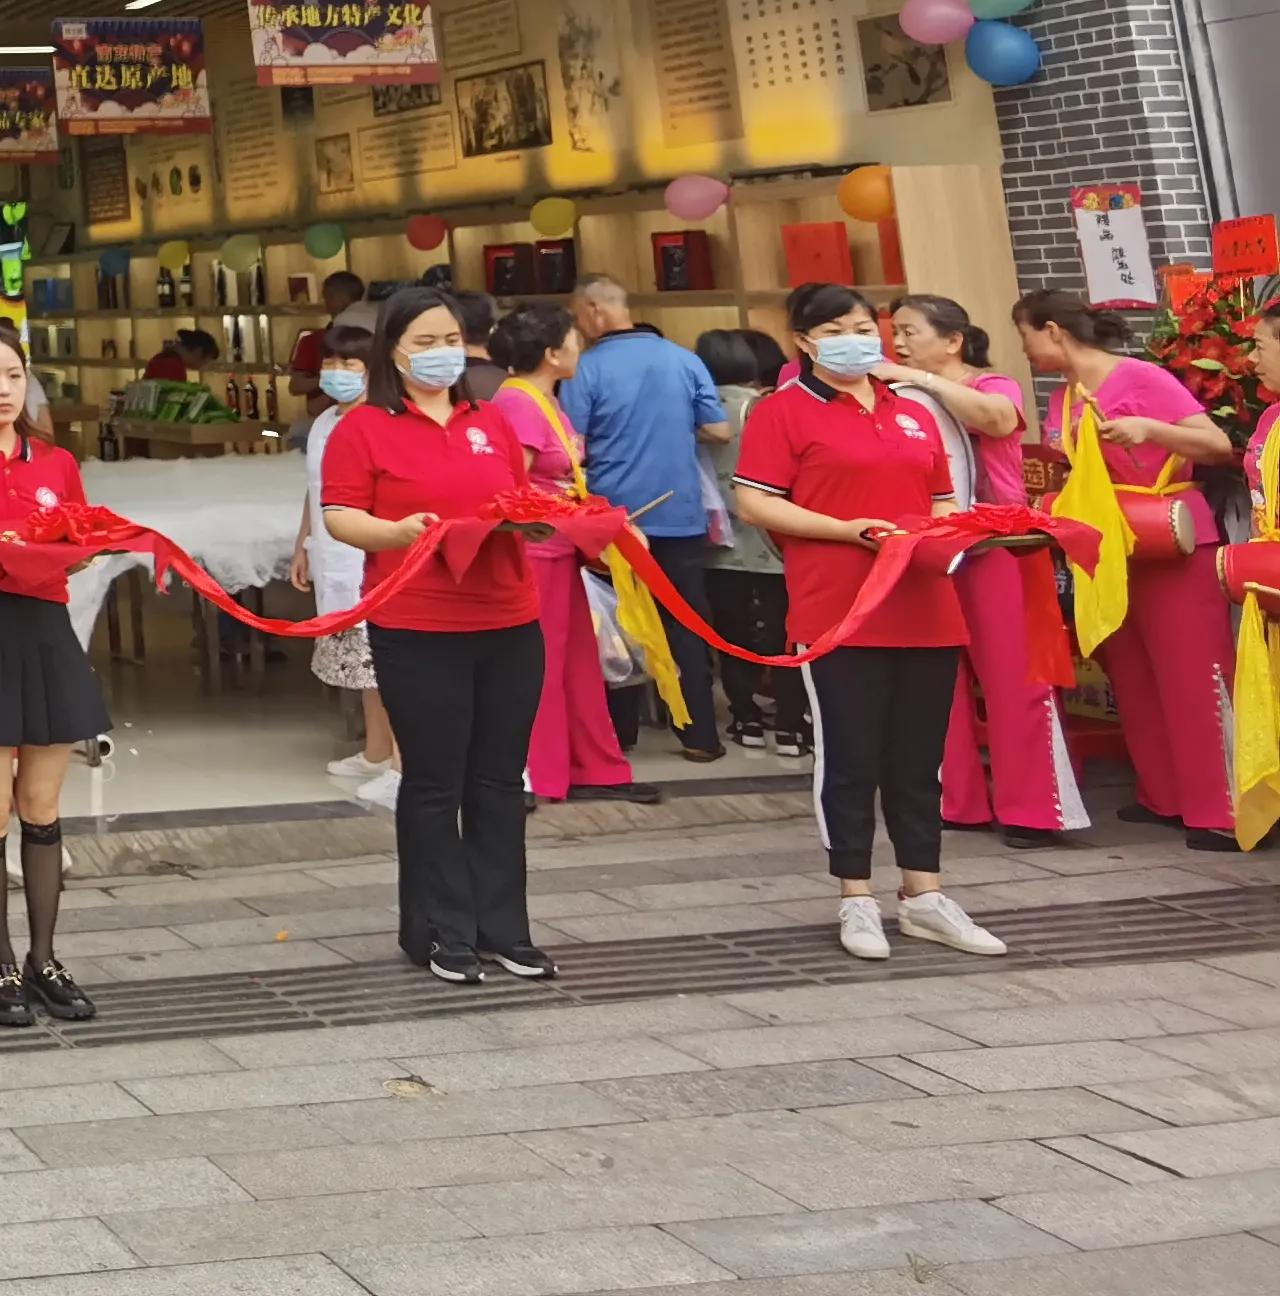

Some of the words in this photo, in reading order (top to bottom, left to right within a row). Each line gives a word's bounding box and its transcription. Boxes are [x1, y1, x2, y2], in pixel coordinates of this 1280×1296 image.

[70, 63, 194, 91] 直达原产地
